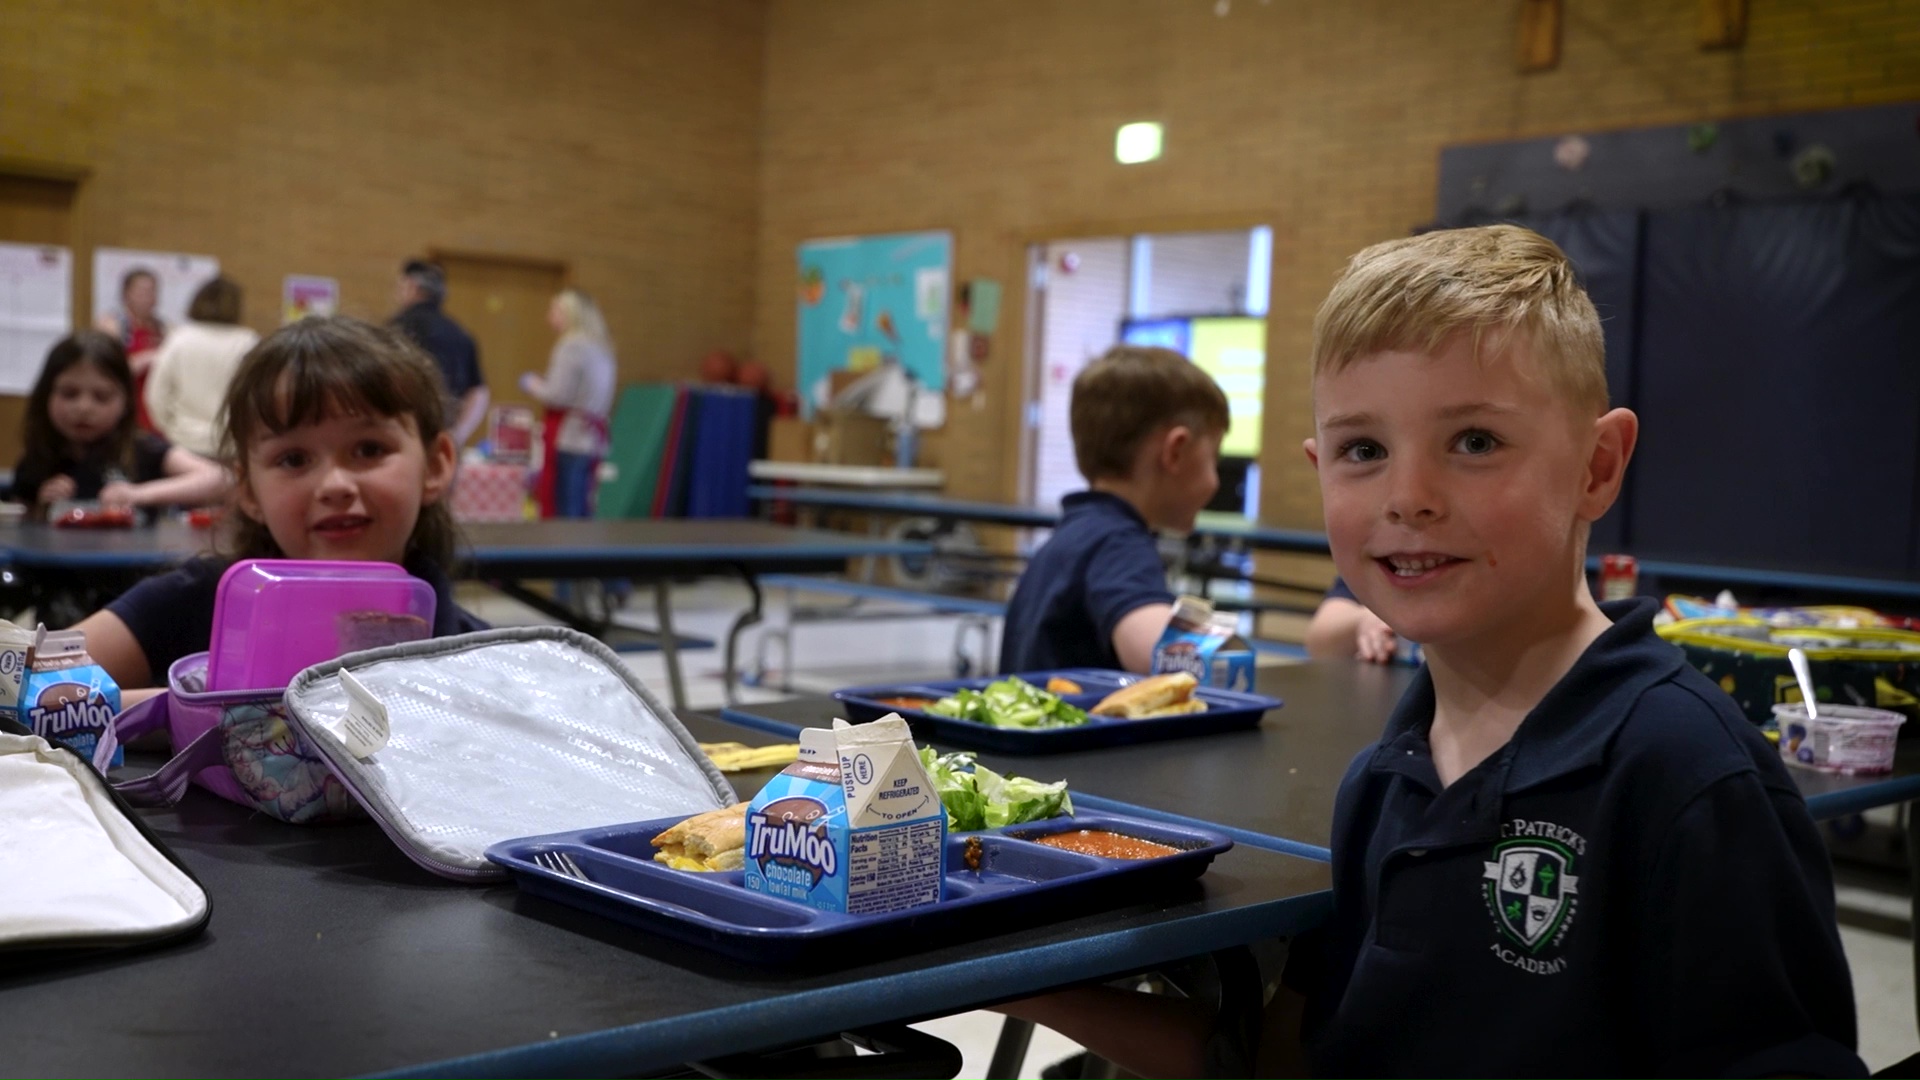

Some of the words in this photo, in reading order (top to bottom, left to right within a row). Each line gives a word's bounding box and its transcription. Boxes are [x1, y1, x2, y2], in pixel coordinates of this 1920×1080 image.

[15, 651, 26, 672] PUSH
[12, 674, 22, 685] UP
[30, 701, 113, 738] TruMoo
[841, 756, 852, 769] UP
[858, 760, 868, 780] HERE
[844, 772, 856, 799] PUSH
[893, 778, 908, 788] KEEP
[879, 786, 920, 800] REFRIGERATED
[882, 812, 894, 820] TO
[895, 808, 918, 820] OPEN
[750, 815, 836, 875] TruMoo
[851, 833, 878, 844] Nutrition
[850, 844, 868, 853] Facts
[765, 861, 811, 887] chocolate
[747, 875, 760, 890] 150
[768, 880, 791, 896] lowfat
